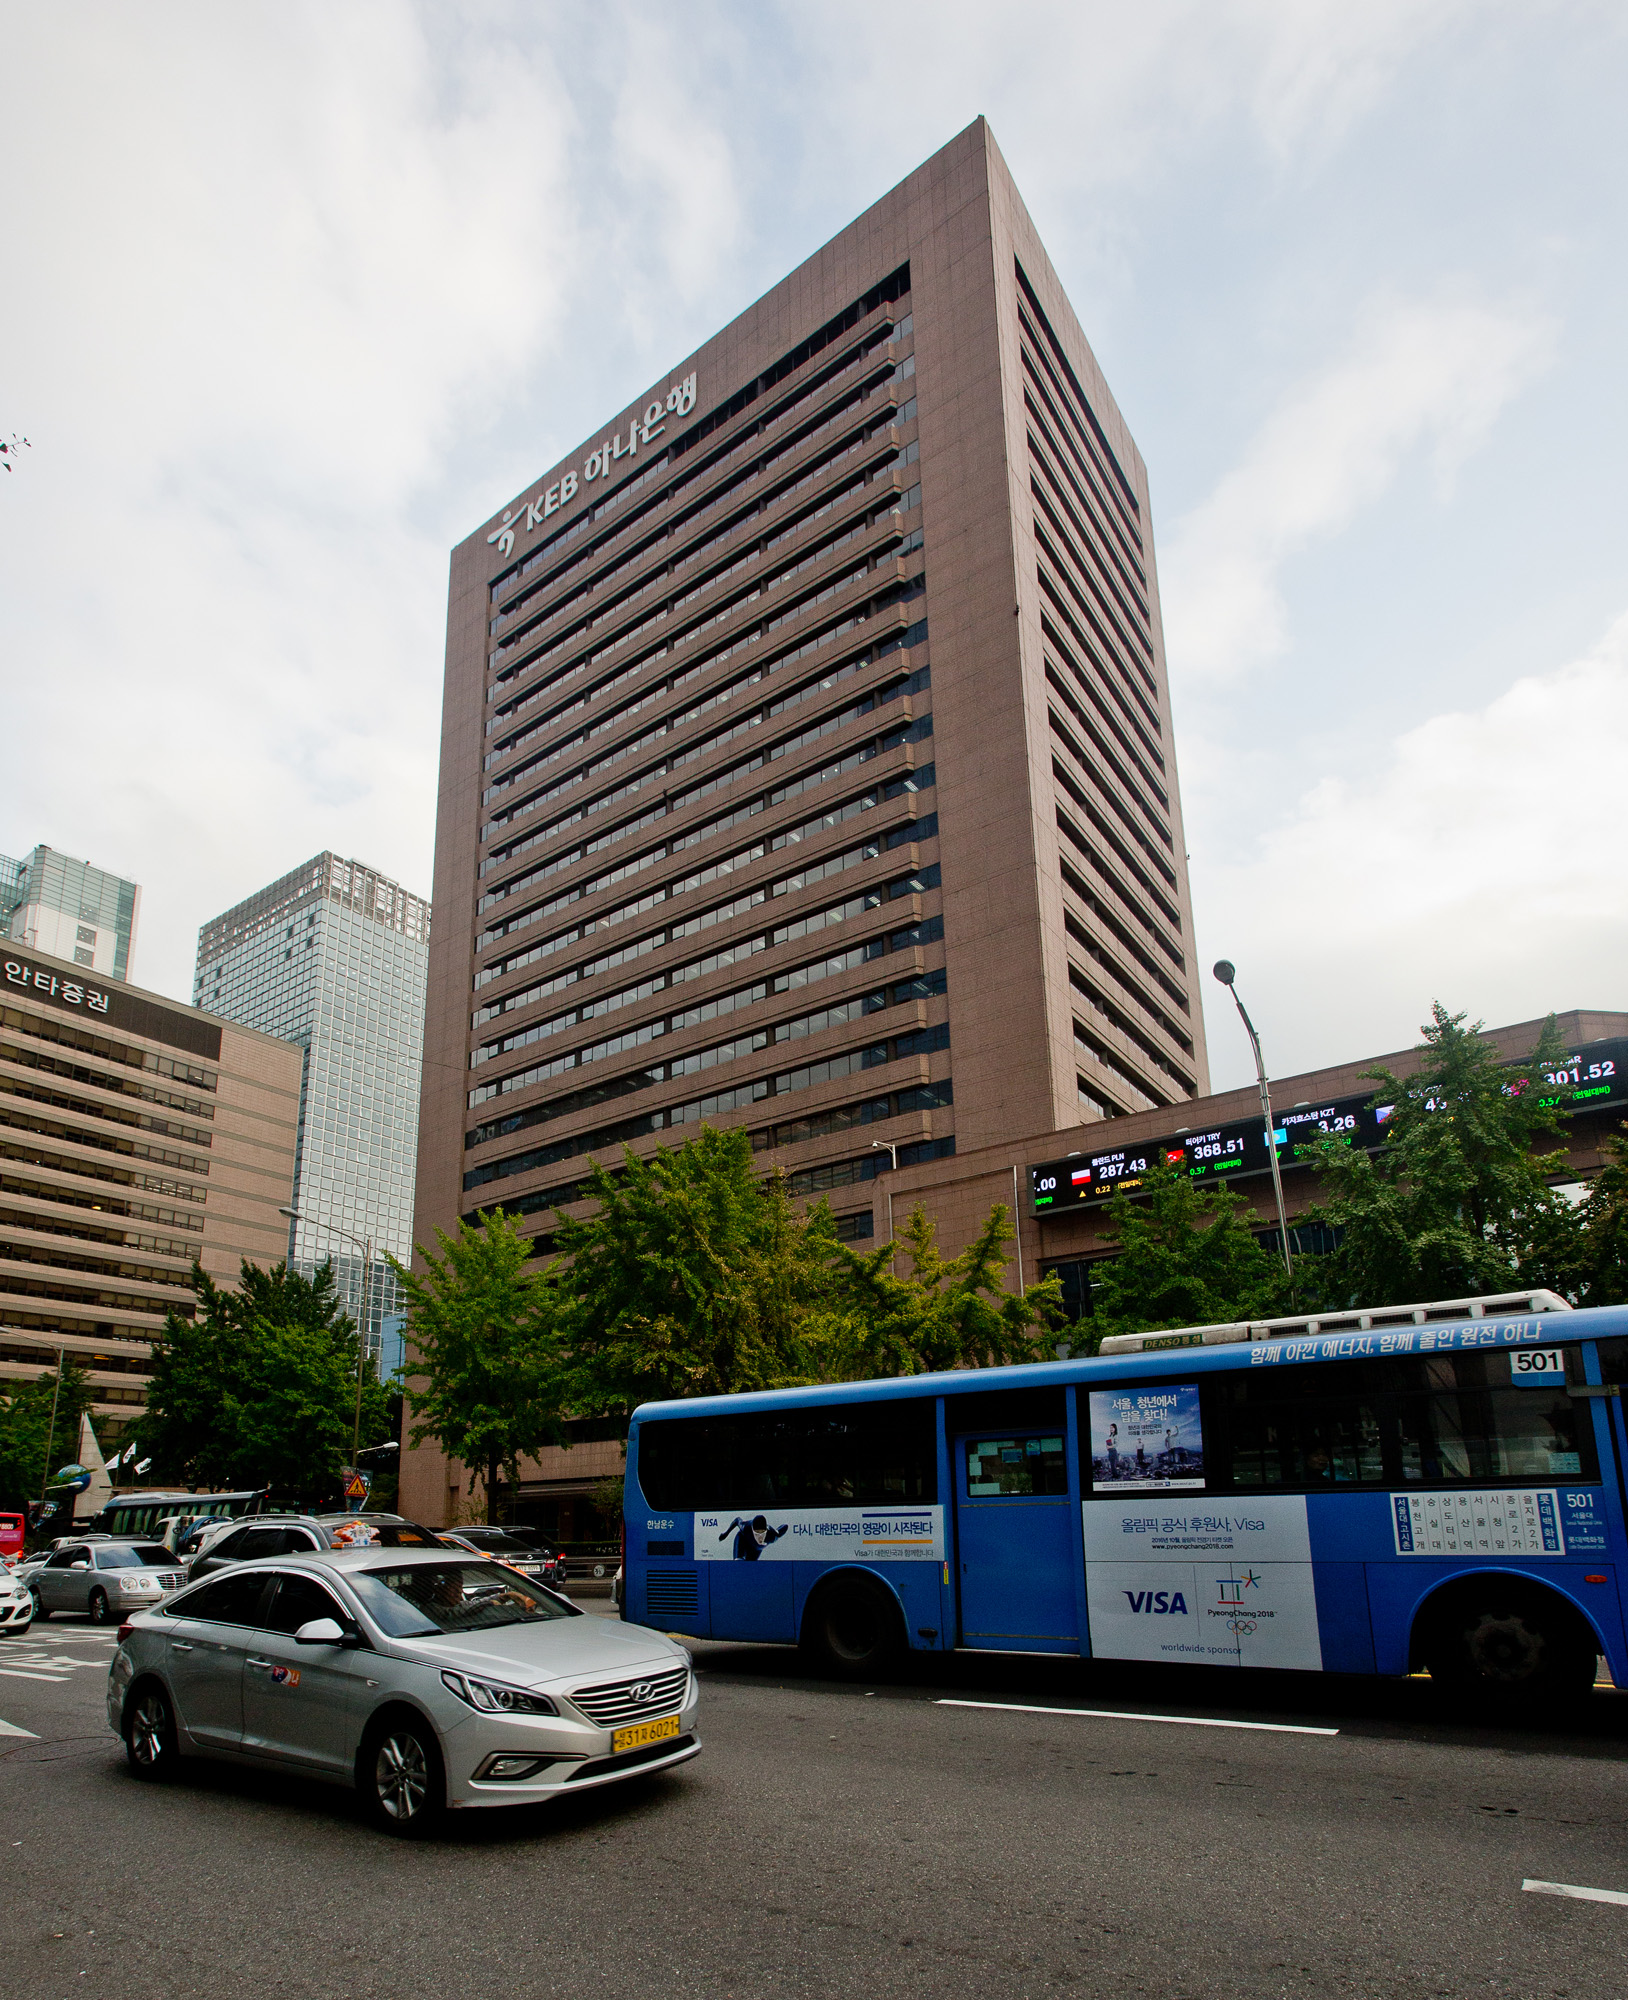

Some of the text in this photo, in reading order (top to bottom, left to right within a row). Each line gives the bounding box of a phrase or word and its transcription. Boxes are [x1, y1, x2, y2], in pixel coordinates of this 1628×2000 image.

[527, 371, 697, 531] KEB 하나은행
[4, 961, 109, 1013] 안타증권
[1543, 1061, 1616, 1085] 301.52
[1320, 1107, 1335, 1118] KZT
[1318, 1115, 1355, 1133] 3.26
[1206, 1132, 1221, 1141] TRY
[1194, 1138, 1244, 1159] 368.51
[1111, 1153, 1125, 1162] PLN
[1099, 1158, 1146, 1179] 287.43
[1189, 1166, 1206, 1176] 0.37
[1095, 1185, 1111, 1194] 0.22
[1144, 1337, 1180, 1349] DENSO
[1251, 1321, 1542, 1364] 함께 아낀 에너지, 함께 줄인 원전 하나
[1517, 1352, 1559, 1371] 501
[1112, 1394, 1177, 1410] 서울, 청년에서
[1121, 1408, 1168, 1423] 답을 찾다!
[1566, 1493, 1594, 1507] 501
[647, 1519, 674, 1529] 한남운수
[700, 1518, 718, 1527] VISA
[793, 1521, 933, 1537] 다시, 대한민국의 영광이 시작된다
[1121, 1516, 1265, 1533] 올림픽 공식 후원사, Visa
[1411, 1498, 1425, 1550] 봉천고개
[1442, 1497, 1457, 1550] 상도터널
[1474, 1496, 1488, 1549] 서울역
[1490, 1495, 1505, 1549] 시청앞
[1506, 1495, 1522, 1549] 종로2가
[1539, 1494, 1556, 1549] 롯데백화점
[854, 1549, 873, 1557] Visa가
[1121, 1590, 1188, 1615] VISA
[1207, 1609, 1274, 1618] PyeongChang 2018
[1161, 1643, 1242, 1655] worldwide sponsor
[650, 1720, 674, 1740] 6021
